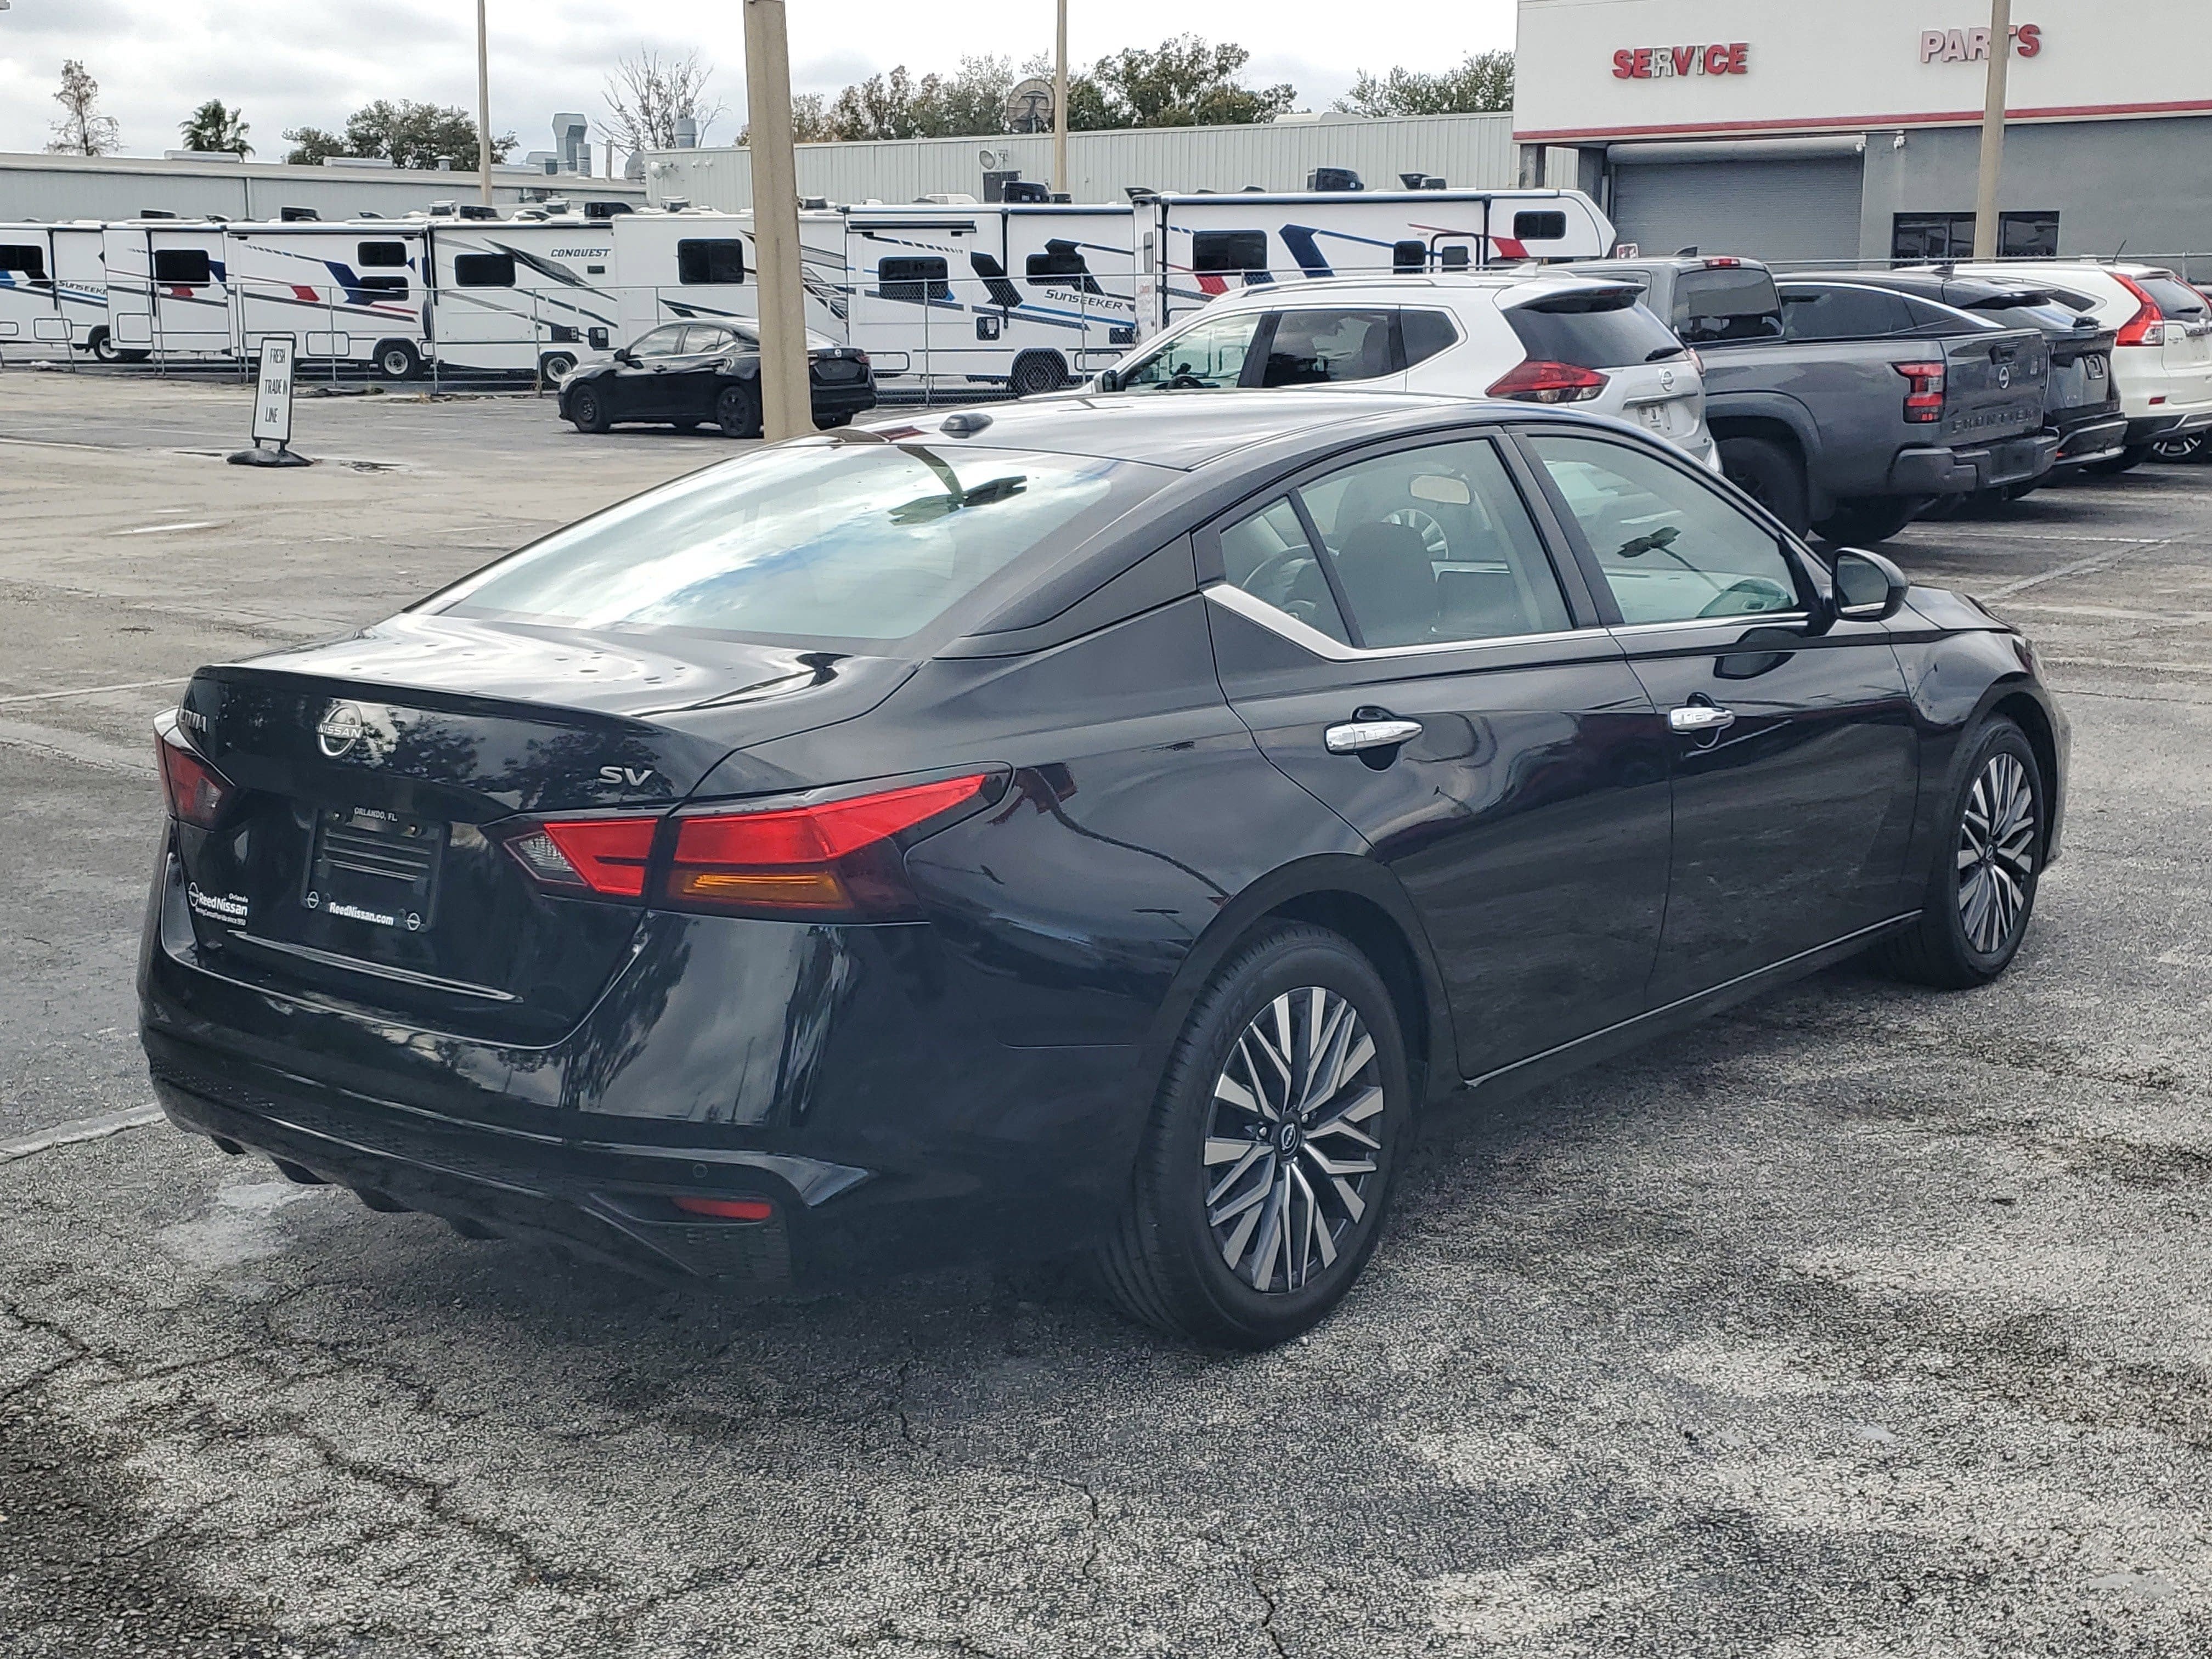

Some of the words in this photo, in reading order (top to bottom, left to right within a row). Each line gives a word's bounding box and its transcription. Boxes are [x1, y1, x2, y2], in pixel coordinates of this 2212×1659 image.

[1612, 43, 1749, 79] SERVICE
[550, 249, 612, 257] CONQUEST
[1044, 289, 1123, 313] SUNSEEKER
[269, 348, 286, 364] FRESH
[264, 379, 283, 395] TRADE
[265, 406, 278, 424] LINE
[318, 724, 362, 738] NISSAN
[598, 766, 654, 786] SV
[330, 902, 394, 926] ReedNissan.com
